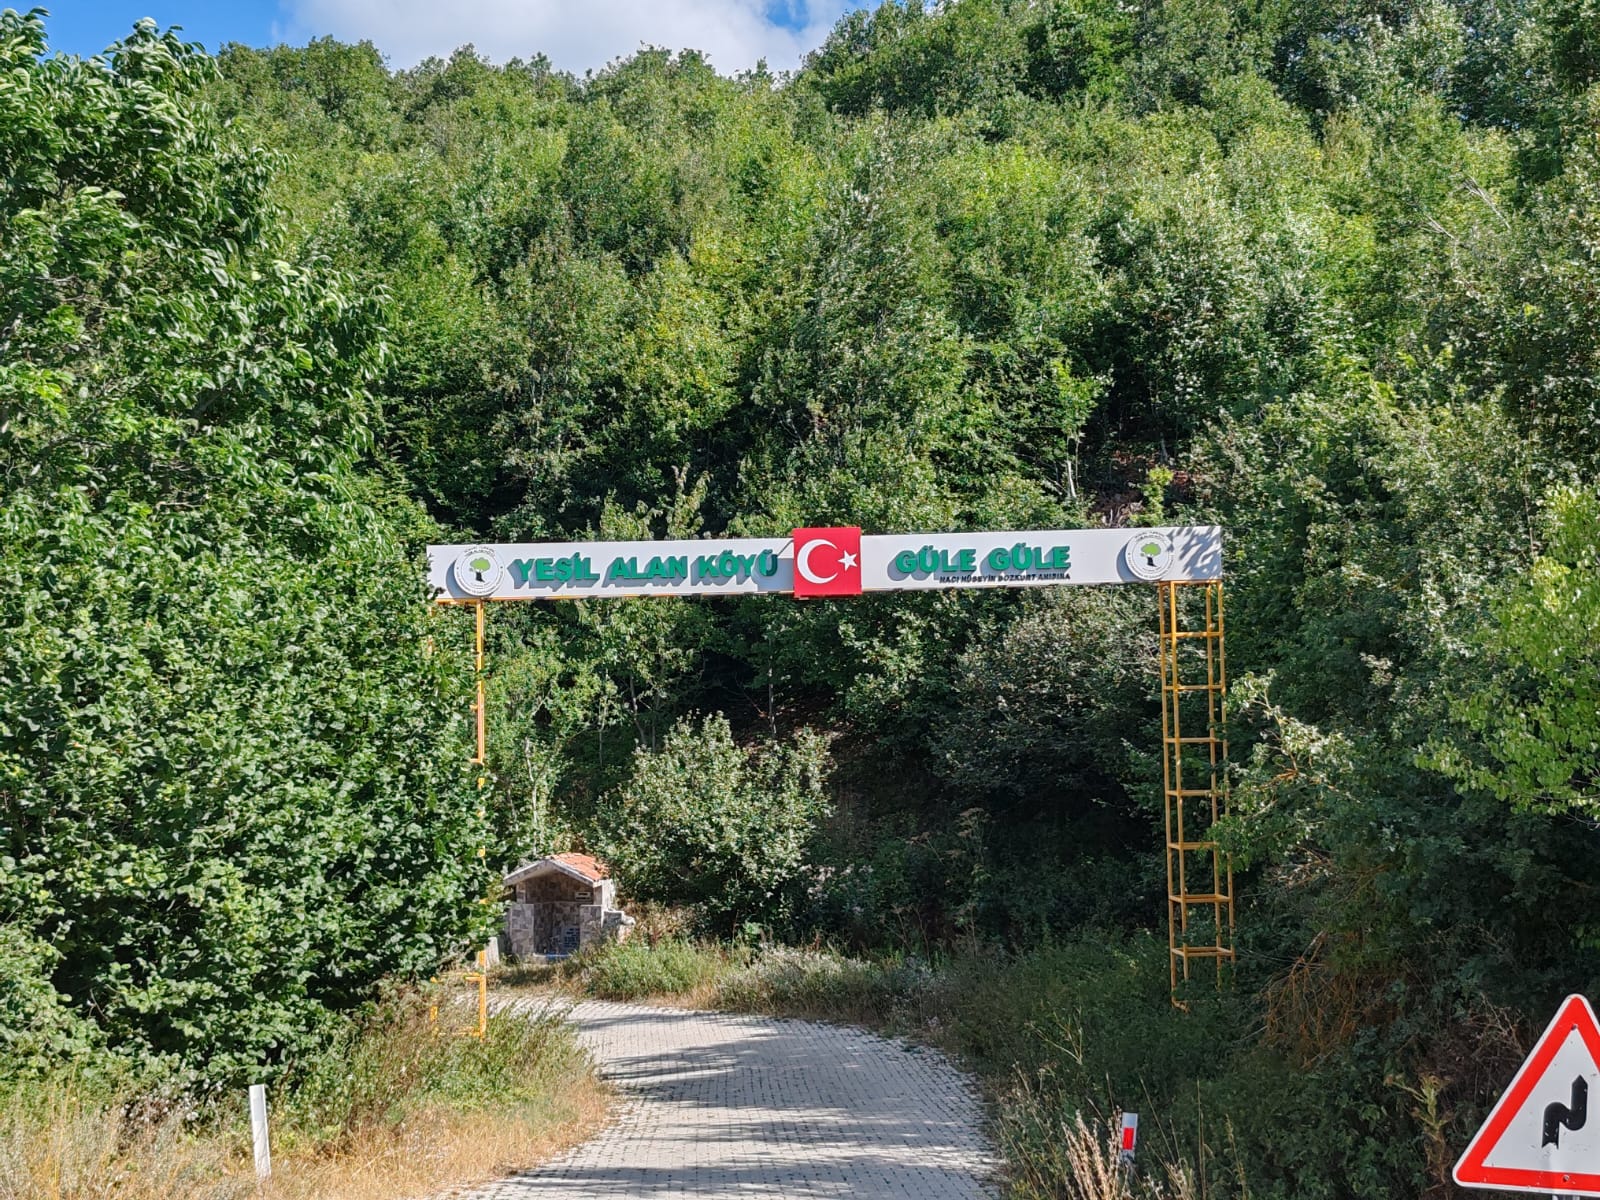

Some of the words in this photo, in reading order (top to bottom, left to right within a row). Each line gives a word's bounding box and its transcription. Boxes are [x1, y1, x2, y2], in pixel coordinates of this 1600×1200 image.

[512, 551, 601, 583] YEŞİL
[609, 555, 688, 580] ALAN
[698, 548, 779, 578] KÖYÜ
[894, 545, 977, 574] GÜLE
[987, 542, 1072, 570] GÜLE
